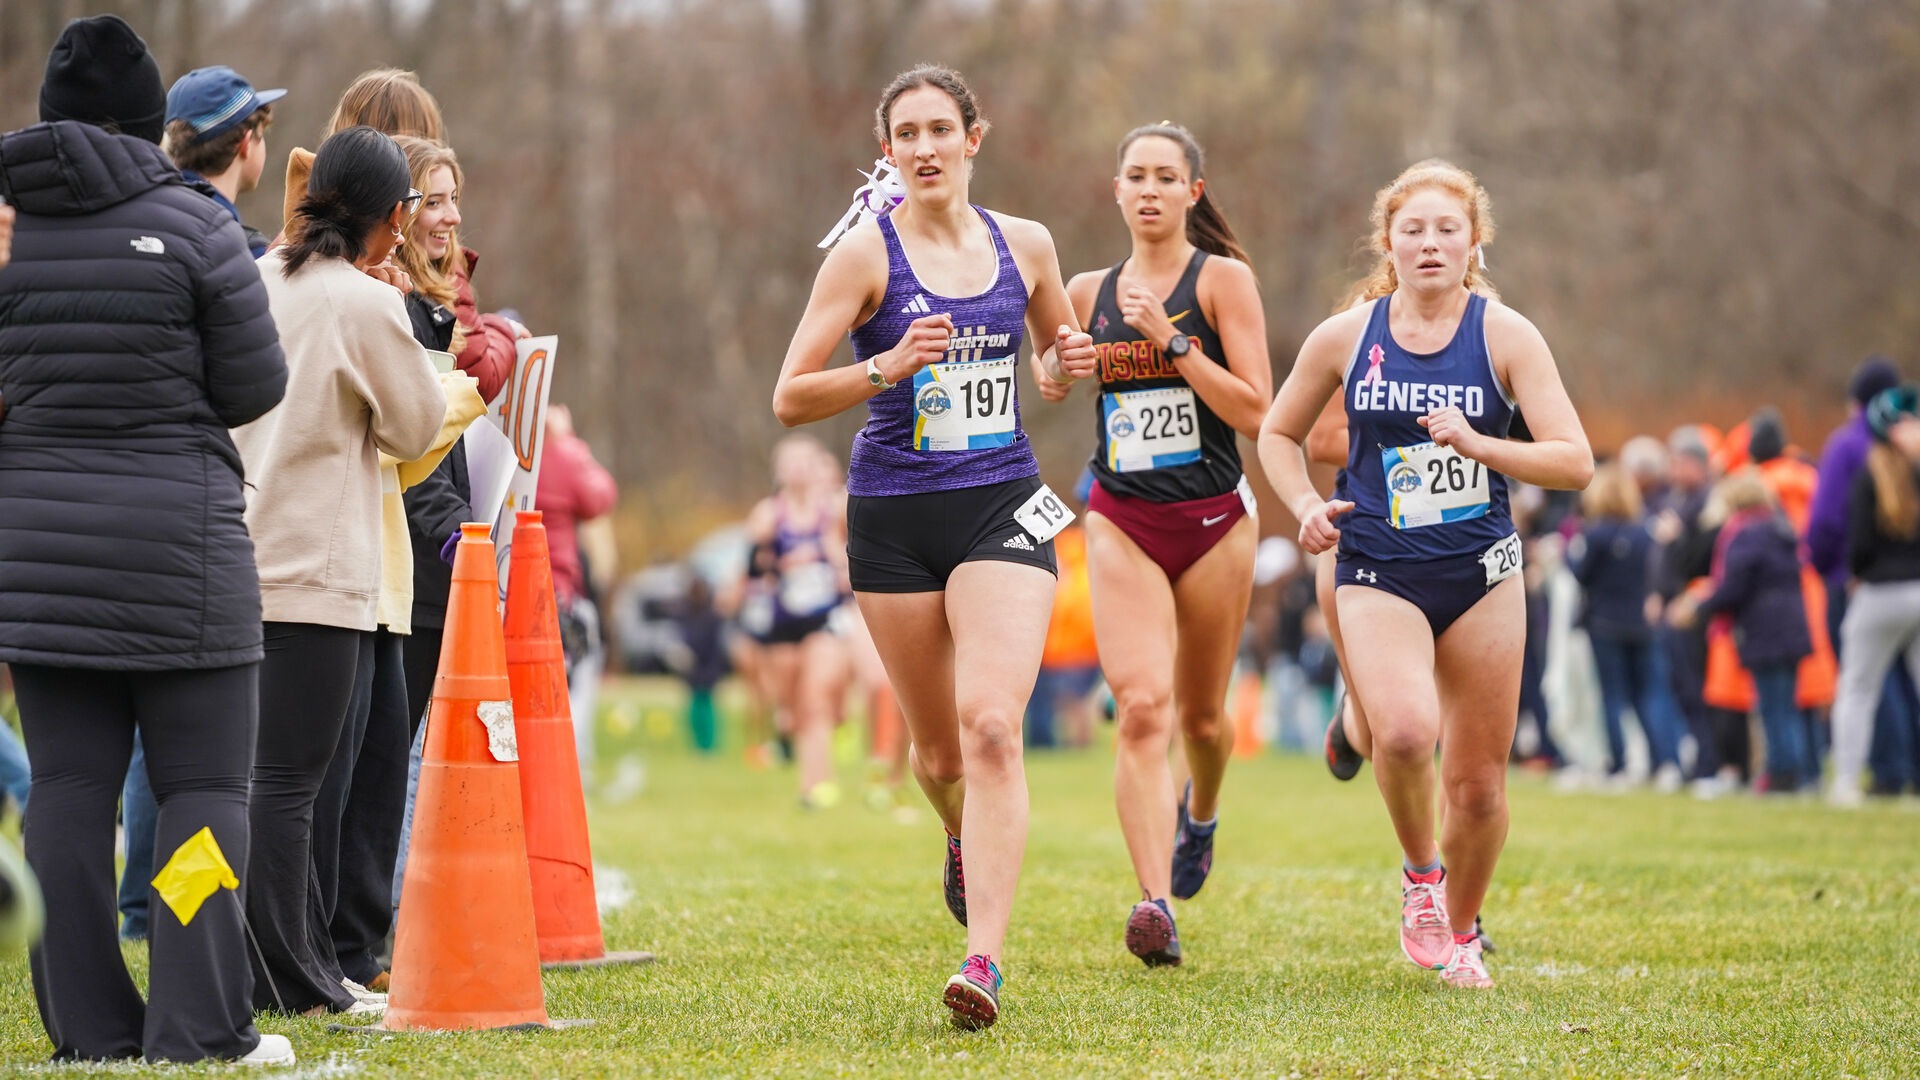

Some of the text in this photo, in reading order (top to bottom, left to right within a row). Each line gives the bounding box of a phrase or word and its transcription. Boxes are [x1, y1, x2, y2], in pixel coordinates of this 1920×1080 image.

[960, 376, 1011, 419] 197
[1354, 380, 1484, 417] GENESEO
[1140, 403, 1194, 441] 225
[1427, 455, 1480, 495] 267
[1003, 541, 1035, 552] adidas
